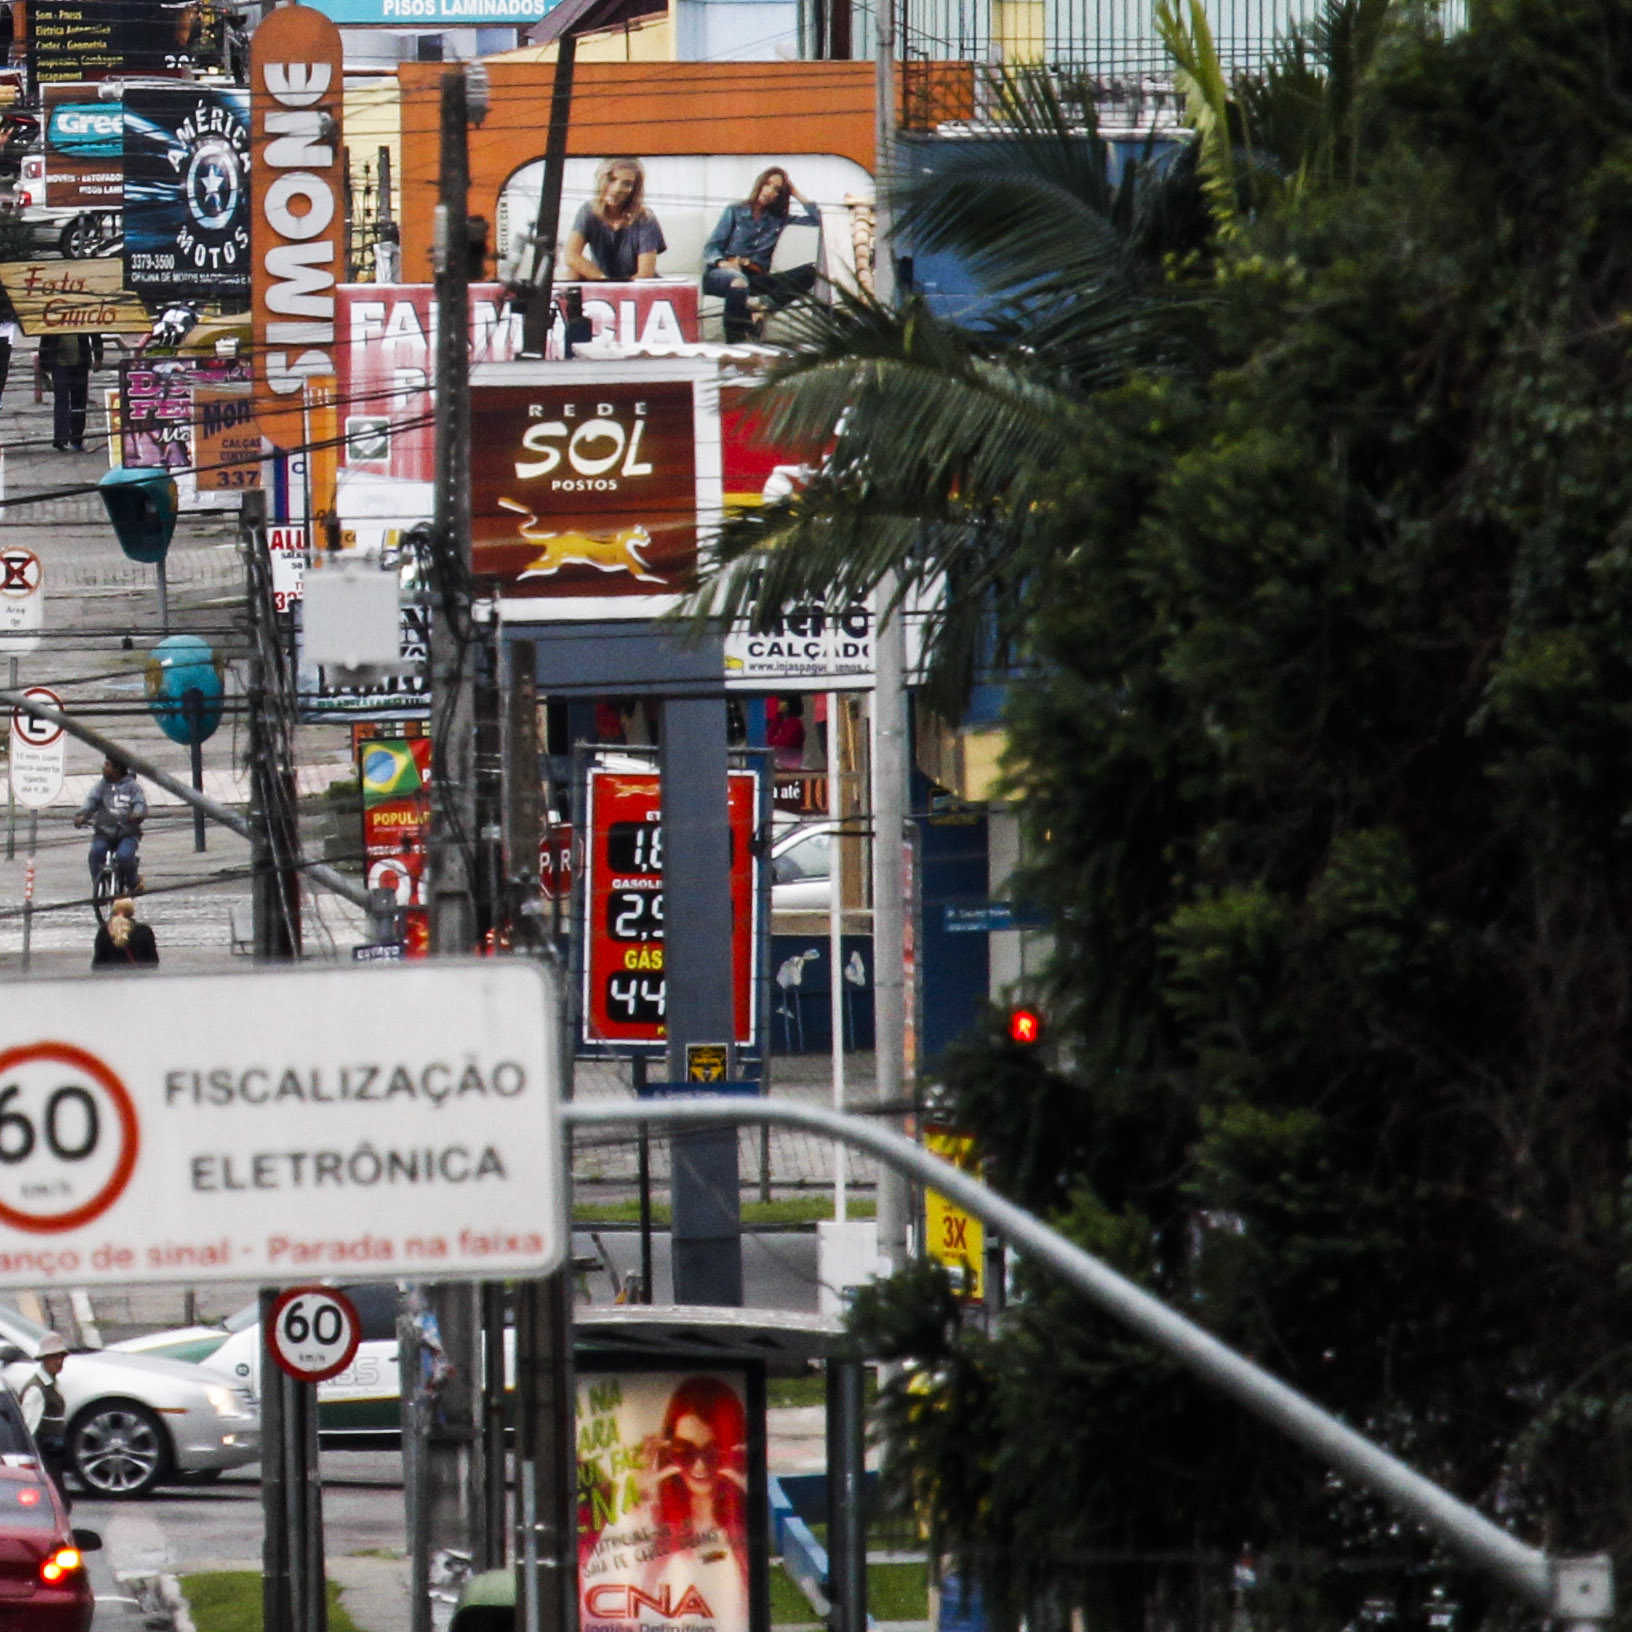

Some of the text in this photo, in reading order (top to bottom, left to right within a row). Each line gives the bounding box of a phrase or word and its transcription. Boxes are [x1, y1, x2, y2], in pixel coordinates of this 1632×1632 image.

[176, 224, 249, 269] MOTOS
[263, 61, 336, 395] SIMONE
[130, 253, 176, 270] 3379-3500
[130, 271, 160, 283] OFICINA
[160, 272, 172, 282] DE
[42, 298, 117, 327] Guido
[528, 402, 649, 417] REDE
[514, 418, 654, 479] SOL
[551, 478, 618, 491] POSTOS
[780, 780, 802, 800] até
[164, 1055, 527, 1109] FISCALIZAÇÃO
[190, 1140, 508, 1193] ELETRÔNICA
[91, 1242, 136, 1270] de
[145, 1237, 230, 1268] sinal
[267, 1232, 393, 1264] Parada
[403, 1237, 448, 1260] na
[460, 1227, 544, 1257] faixa
[943, 1216, 967, 1250] 3X
[283, 1300, 343, 1346] 60
[582, 1583, 716, 1620] CNA
